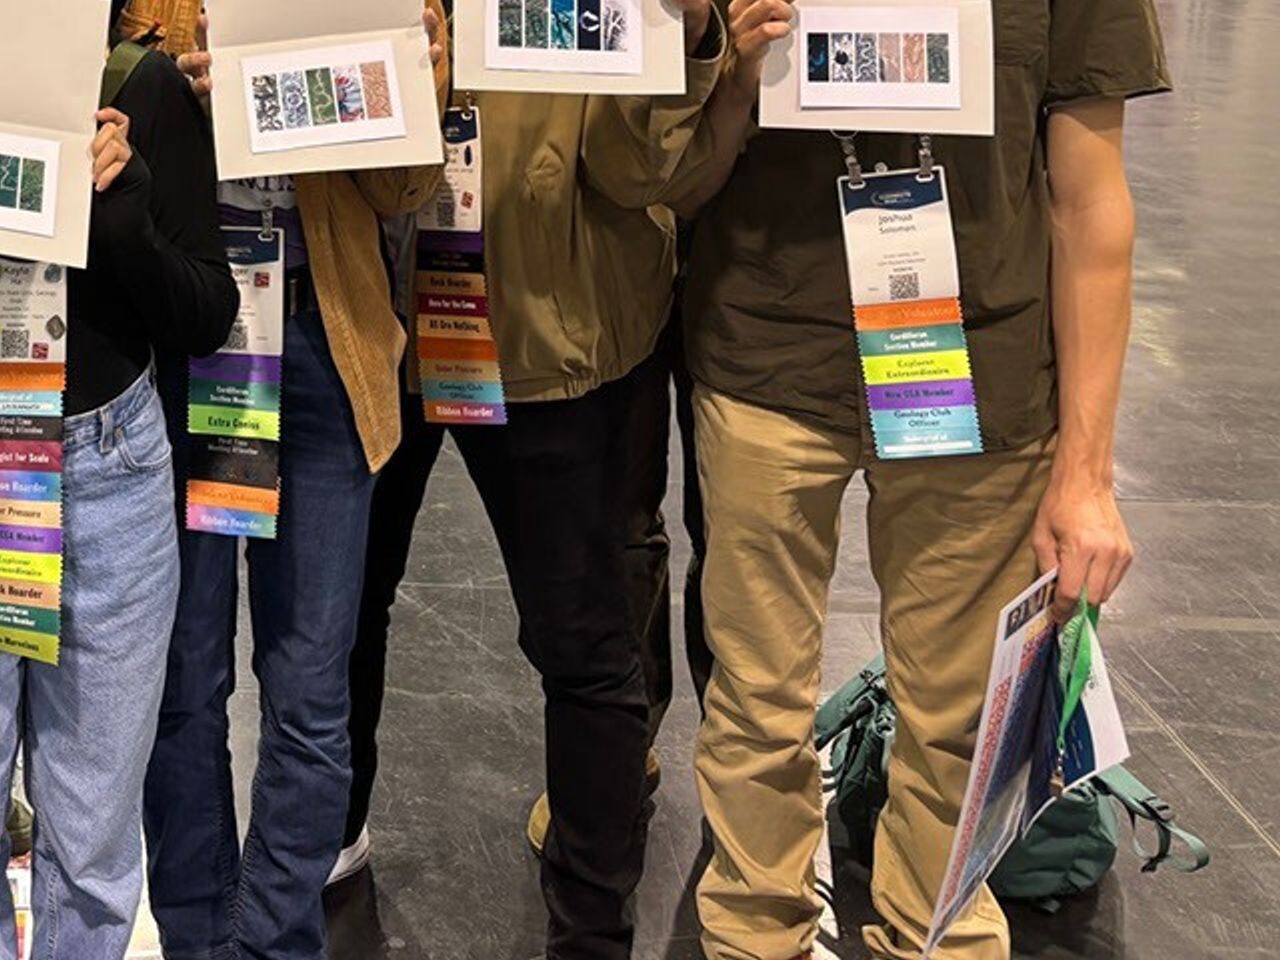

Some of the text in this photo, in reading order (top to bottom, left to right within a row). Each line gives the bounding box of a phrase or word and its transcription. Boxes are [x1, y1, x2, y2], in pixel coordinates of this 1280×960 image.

[878, 214, 913, 226] Joshua
[208, 416, 230, 428] Extra
[14, 452, 27, 461] for
[28, 453, 50, 463] Scale
[8, 584, 43, 599] Hoarder
